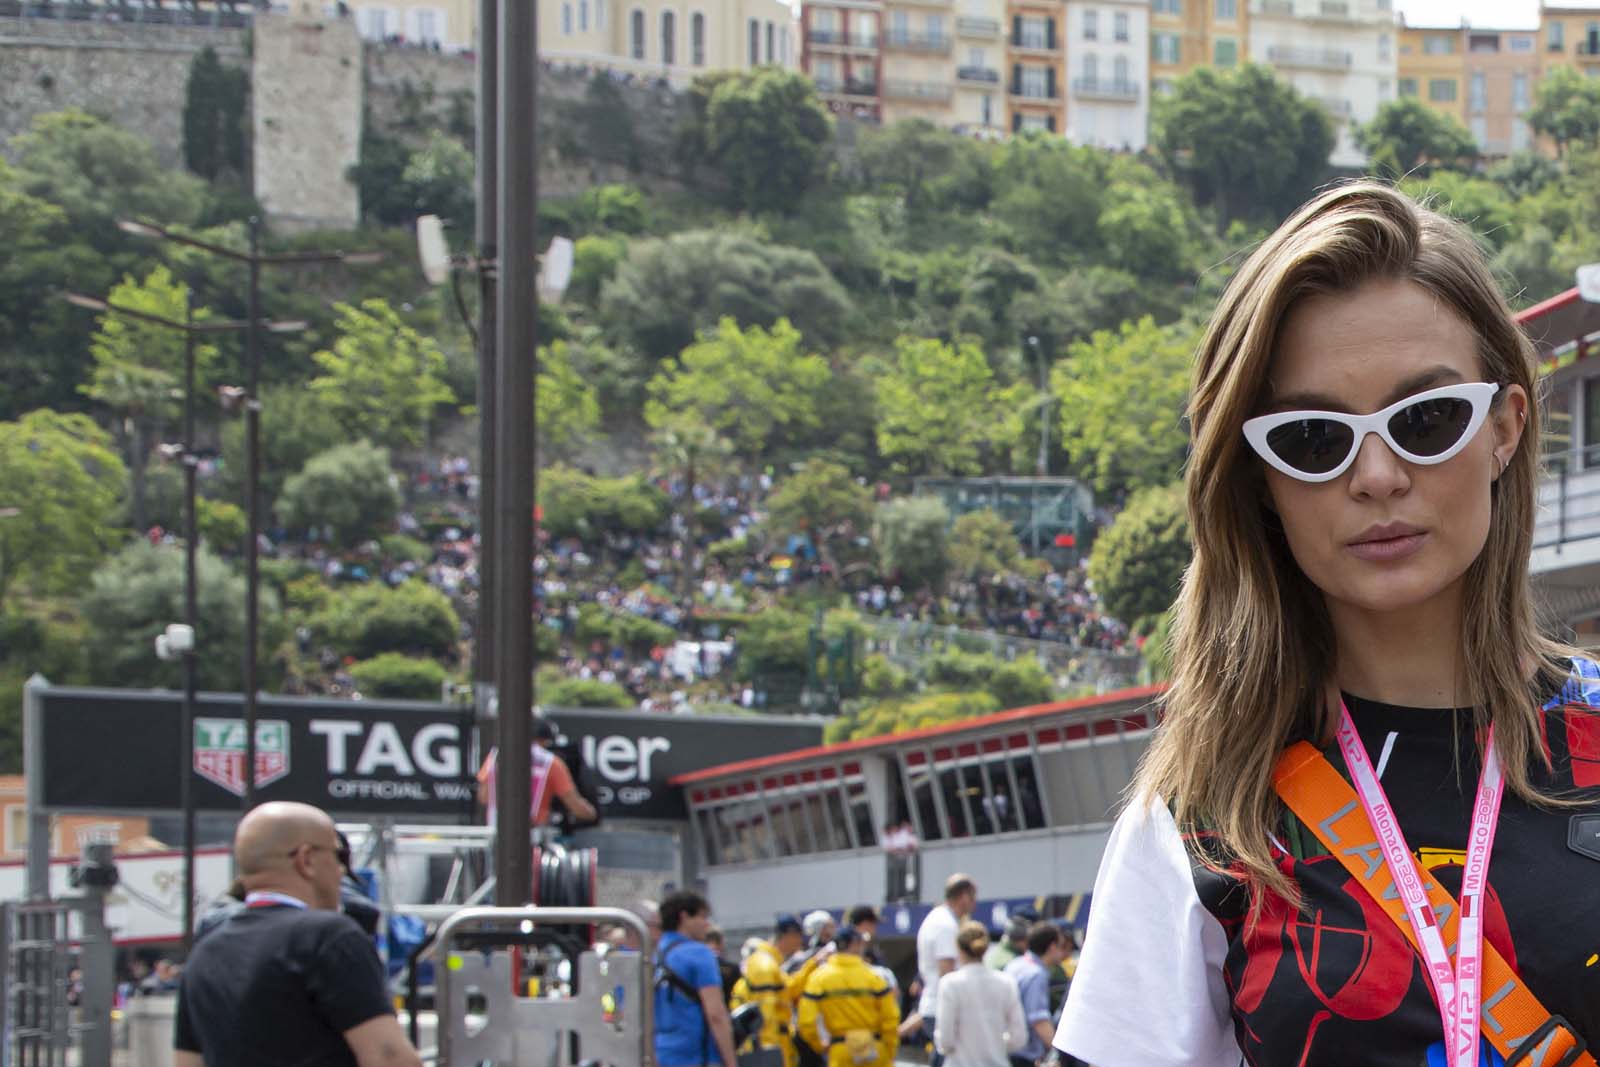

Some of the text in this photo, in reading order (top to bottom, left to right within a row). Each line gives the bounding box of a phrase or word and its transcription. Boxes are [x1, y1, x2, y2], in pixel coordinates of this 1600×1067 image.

[309, 720, 462, 777] TAG
[1373, 803, 1425, 904] Monaco 2019
[1466, 826, 1489, 890] Monaco
[1460, 991, 1474, 1056] VIP
